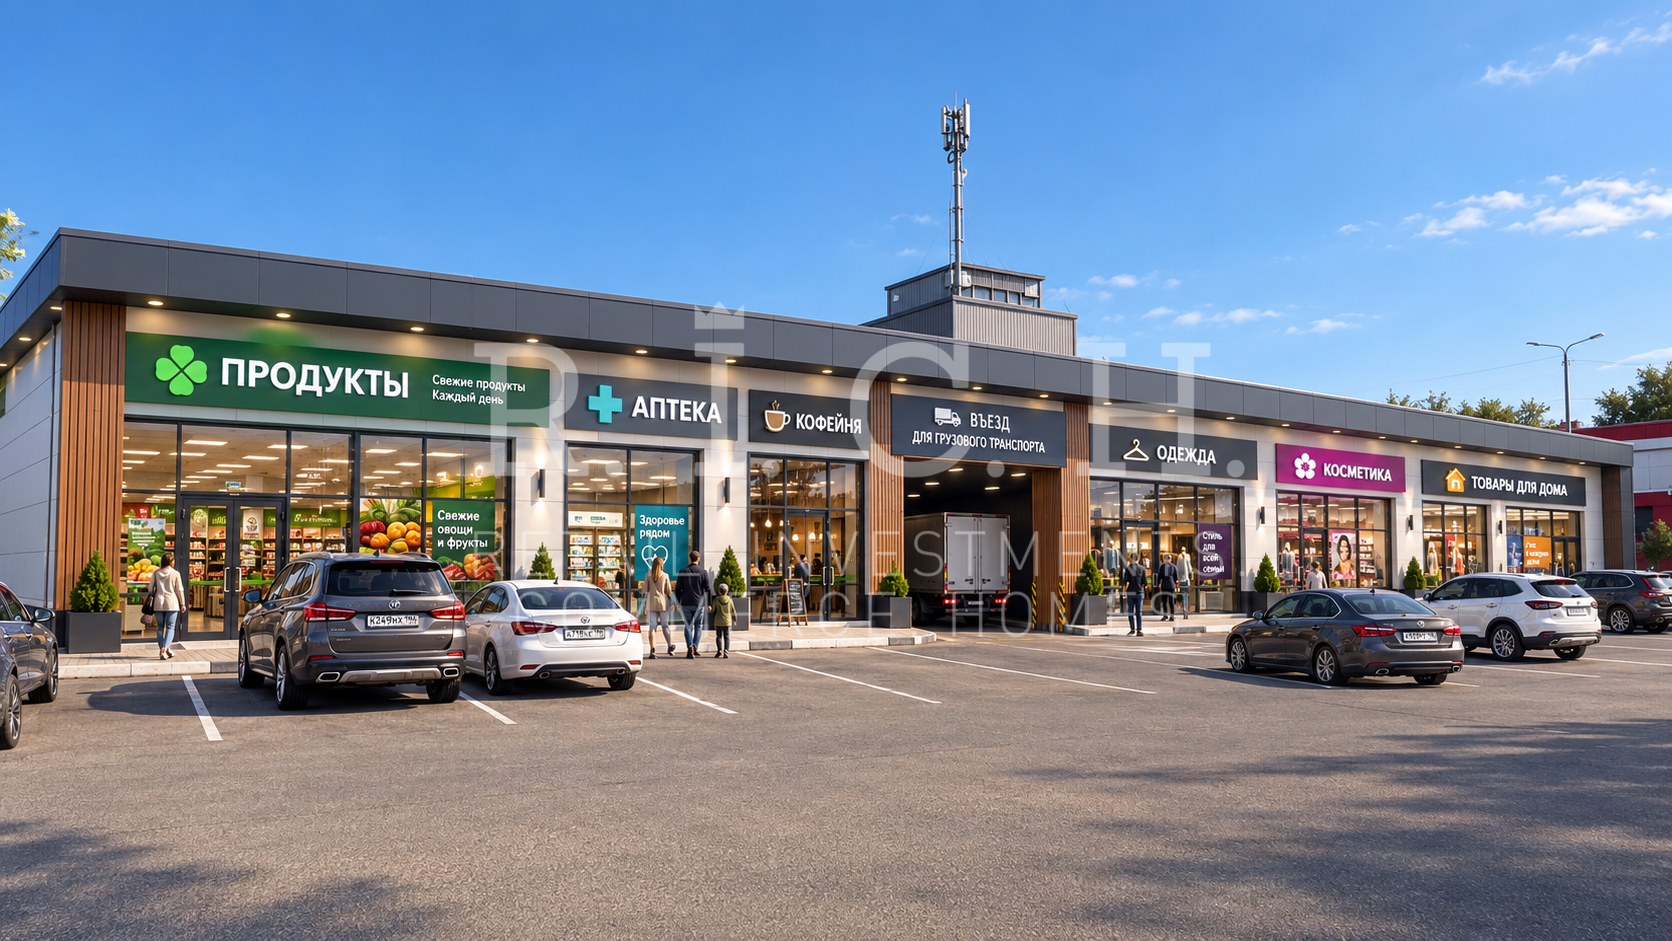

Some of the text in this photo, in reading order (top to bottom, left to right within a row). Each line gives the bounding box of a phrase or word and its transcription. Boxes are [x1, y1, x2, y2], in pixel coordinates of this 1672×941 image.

[221, 357, 409, 399] ПРОДУКТЫ
[432, 374, 526, 393] Свежие продукты
[432, 389, 504, 405] Каждый день
[631, 395, 722, 424] АПТЕКА
[796, 413, 862, 435] КОФЕЙНЯ
[970, 412, 1011, 434] ВЪЕЗД
[912, 430, 1046, 454] ДЛЯ ГРУЗОВОГО ТРАНСПОРТА
[1156, 444, 1217, 467] ОДЕЖДА
[1323, 462, 1393, 482] КОСМЕТИКА
[1471, 475, 1568, 497] ТОВАРЫ ДЛЯ ДОМА
[437, 509, 480, 521] Свежие
[639, 514, 685, 528] Здоровье
[437, 526, 473, 536] овощи
[639, 529, 671, 540] рядом
[437, 536, 488, 550] и фрукты
